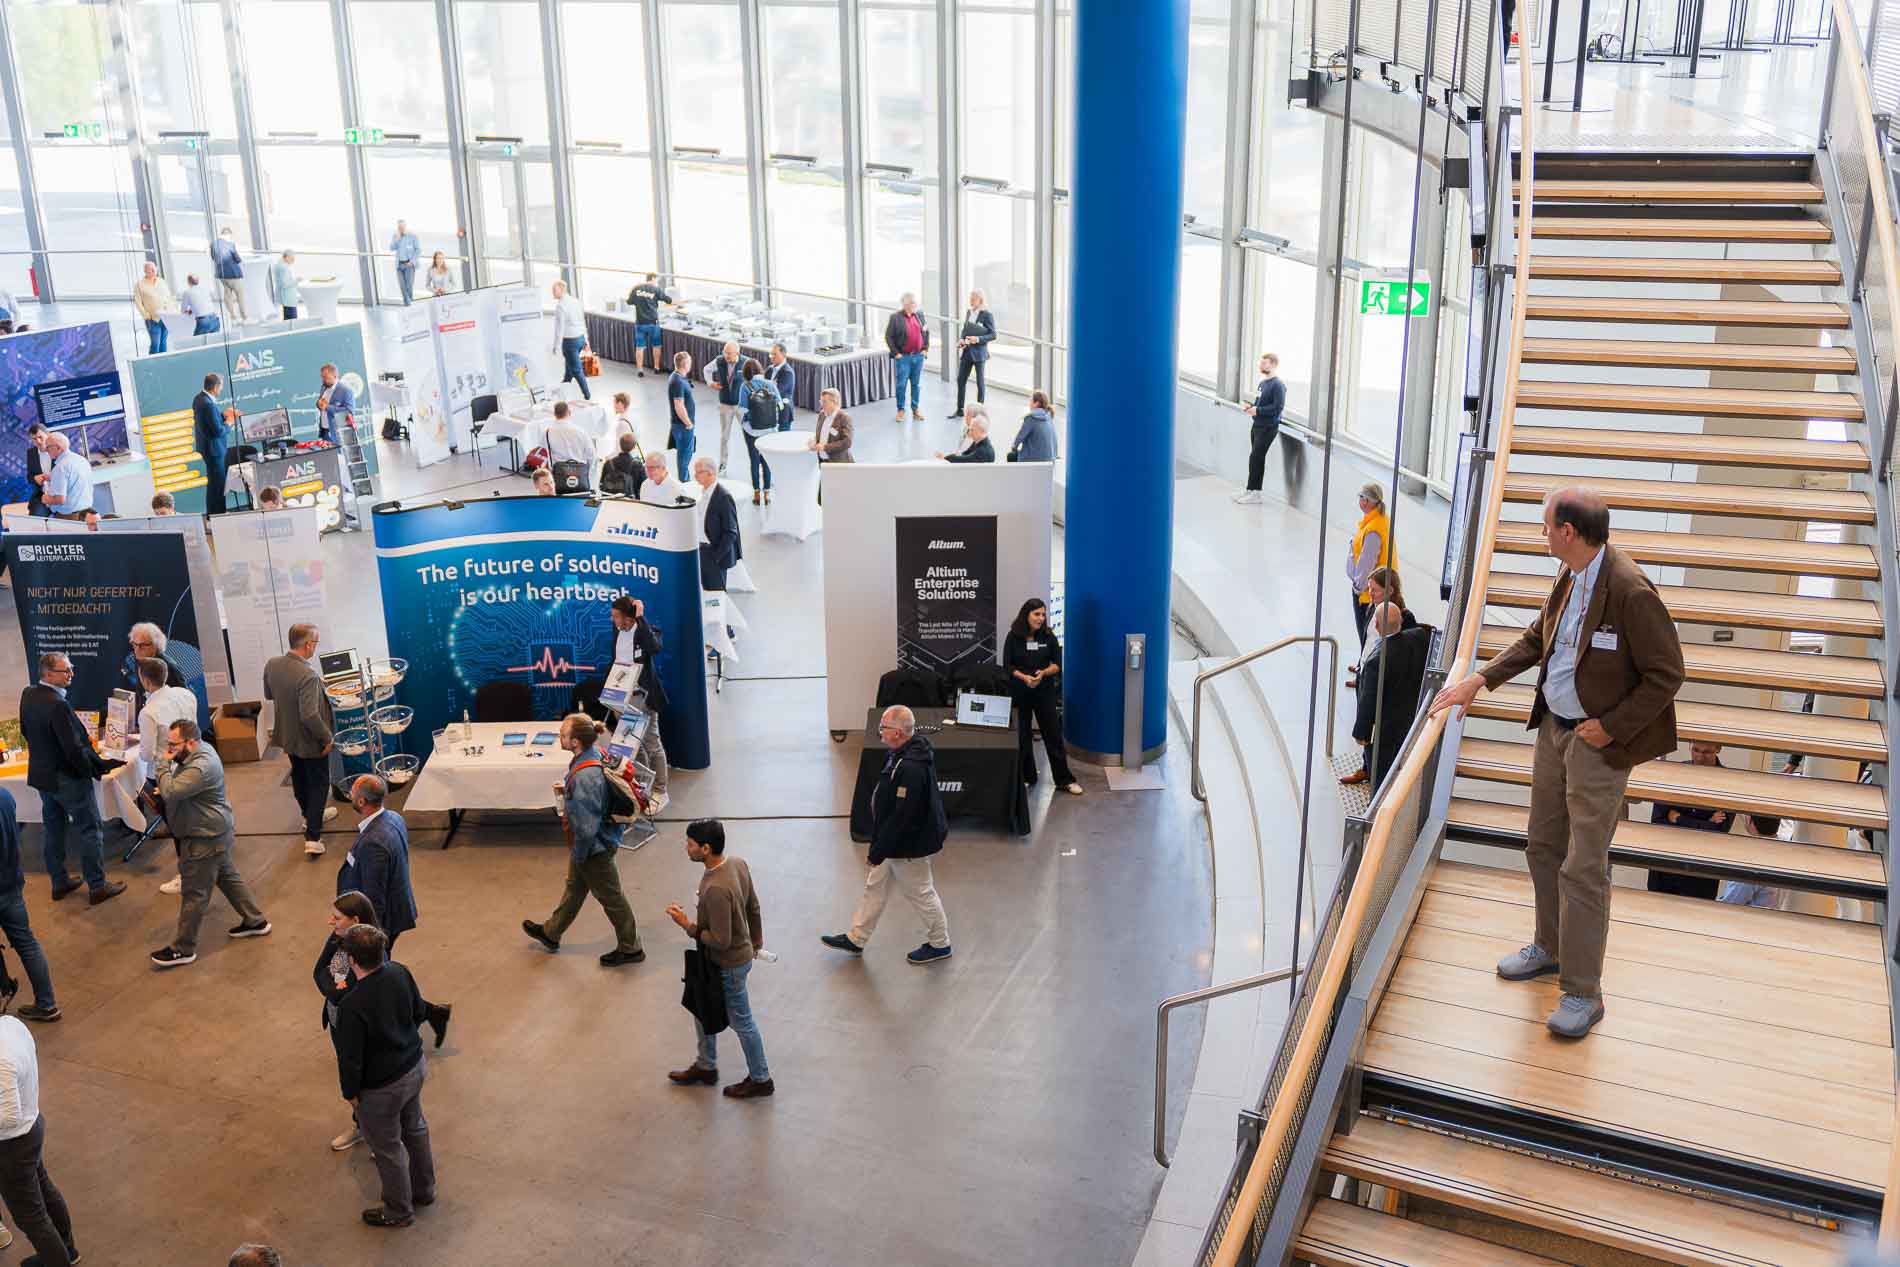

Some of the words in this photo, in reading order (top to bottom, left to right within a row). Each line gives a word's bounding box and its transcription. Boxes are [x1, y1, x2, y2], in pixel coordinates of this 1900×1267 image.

[235, 349, 276, 373] ANS
[285, 461, 316, 480] ANS
[607, 523, 658, 540] almit
[35, 544, 85, 555] RICHTER
[416, 564, 458, 585] The
[464, 557, 534, 578] future
[540, 553, 564, 572] of
[568, 554, 660, 584] soldering
[926, 566, 968, 578] Altium
[914, 577, 980, 590] Enterprise
[27, 587, 59, 598] NICHT
[63, 586, 87, 598] NUR
[90, 585, 153, 598] GEFERTIGT
[459, 588, 477, 607] is
[483, 584, 521, 604] our
[917, 589, 977, 600] Solutions
[37, 602, 112, 615] MITGEDACHT!
